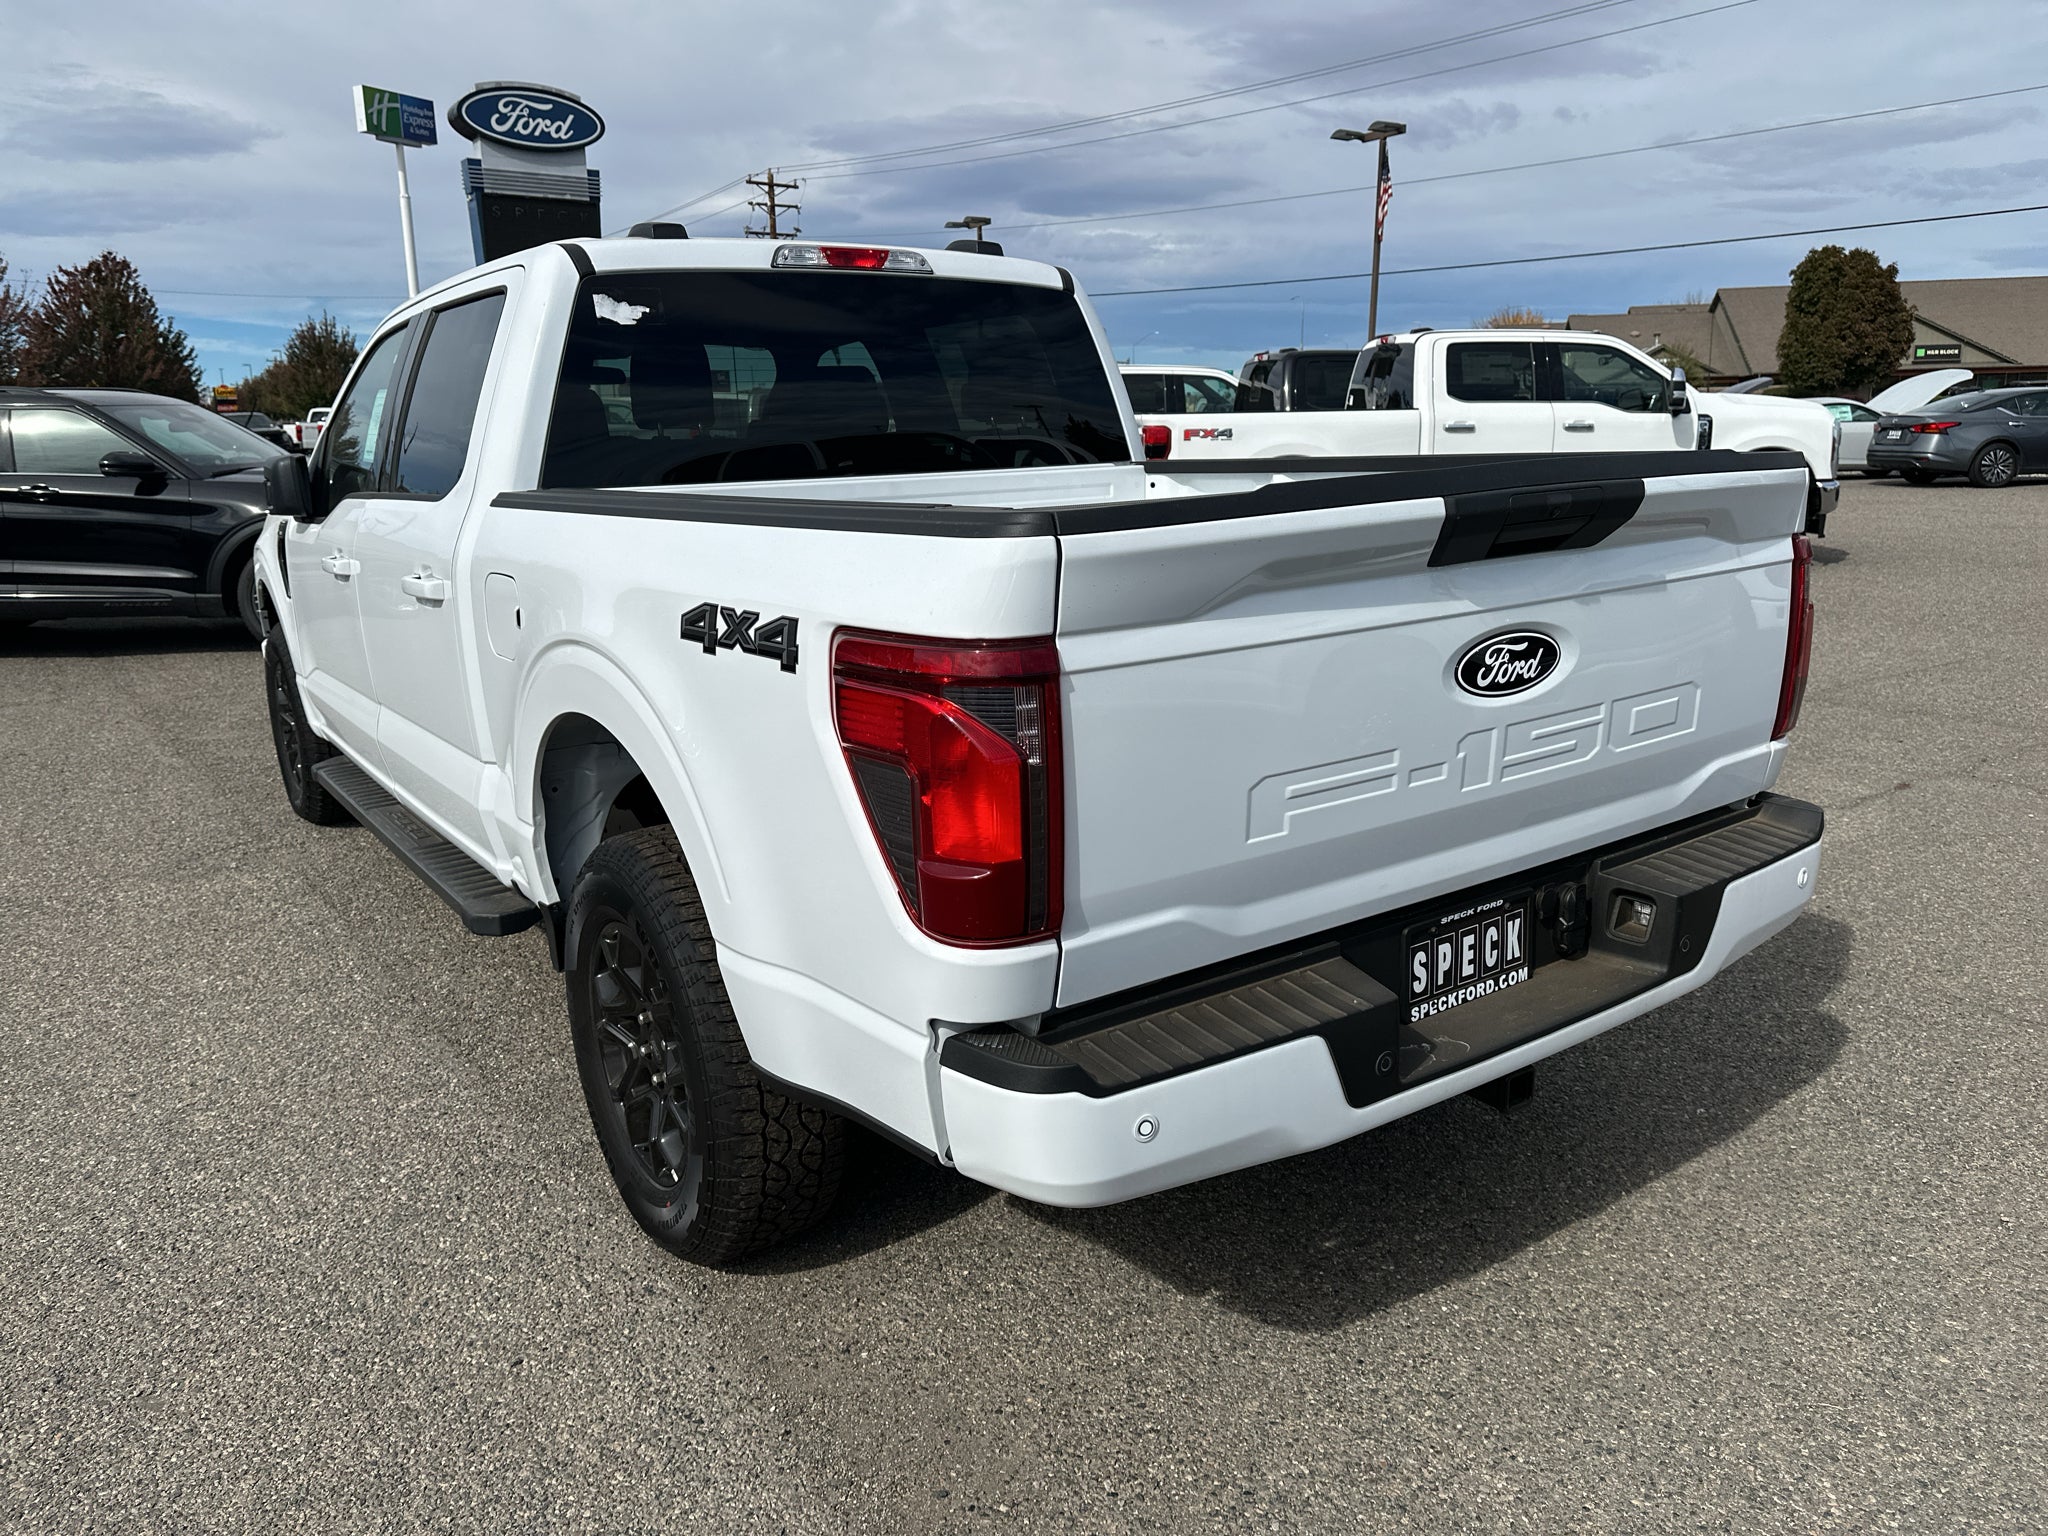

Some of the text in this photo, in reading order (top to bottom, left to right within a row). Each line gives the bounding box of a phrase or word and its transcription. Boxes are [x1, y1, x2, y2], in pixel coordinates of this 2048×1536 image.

[403, 112, 434, 129] Express
[490, 96, 575, 140] Ford
[1183, 428, 1233, 441] FX4
[1476, 641, 1543, 687] Ford
[1245, 680, 1702, 844] F-150
[1440, 899, 1504, 925] SPECK FORD
[1412, 917, 1521, 994] SPECK
[1410, 966, 1528, 1022] SPECKFORD.COM
